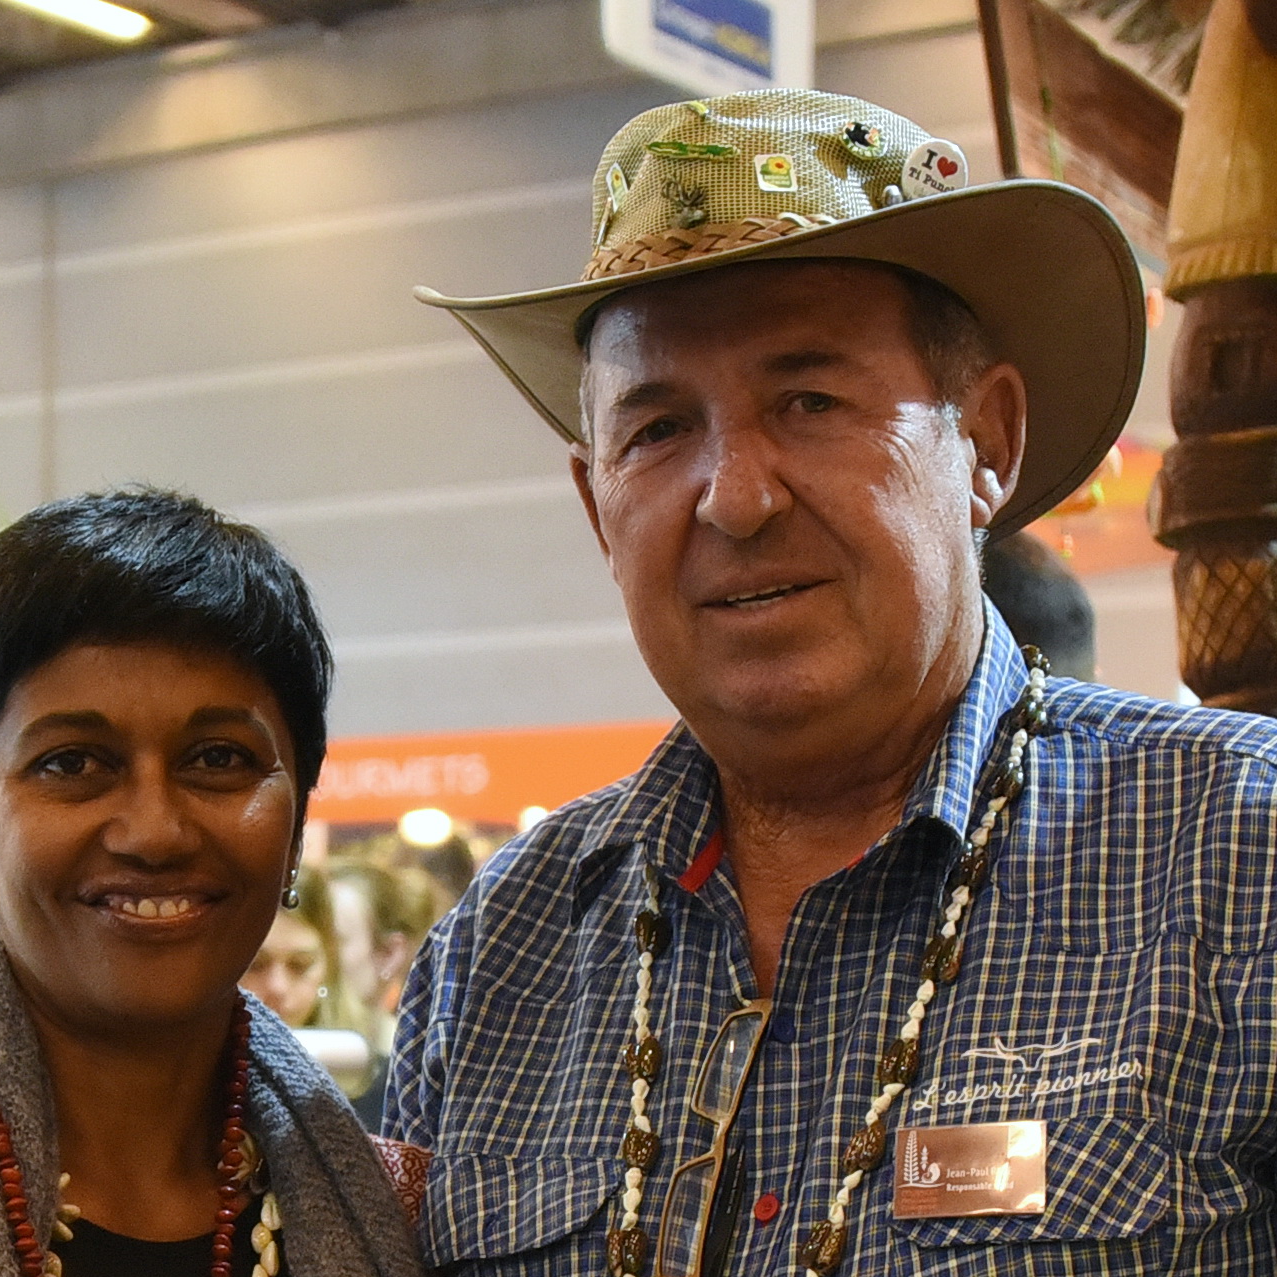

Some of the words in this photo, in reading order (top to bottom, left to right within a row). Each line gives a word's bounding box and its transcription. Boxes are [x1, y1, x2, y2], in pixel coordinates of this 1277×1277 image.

[921, 148, 938, 170] I
[922, 173, 955, 192] Punc
[912, 1073, 1026, 1111] L'esprit
[1031, 1057, 1144, 1103] pionnier
